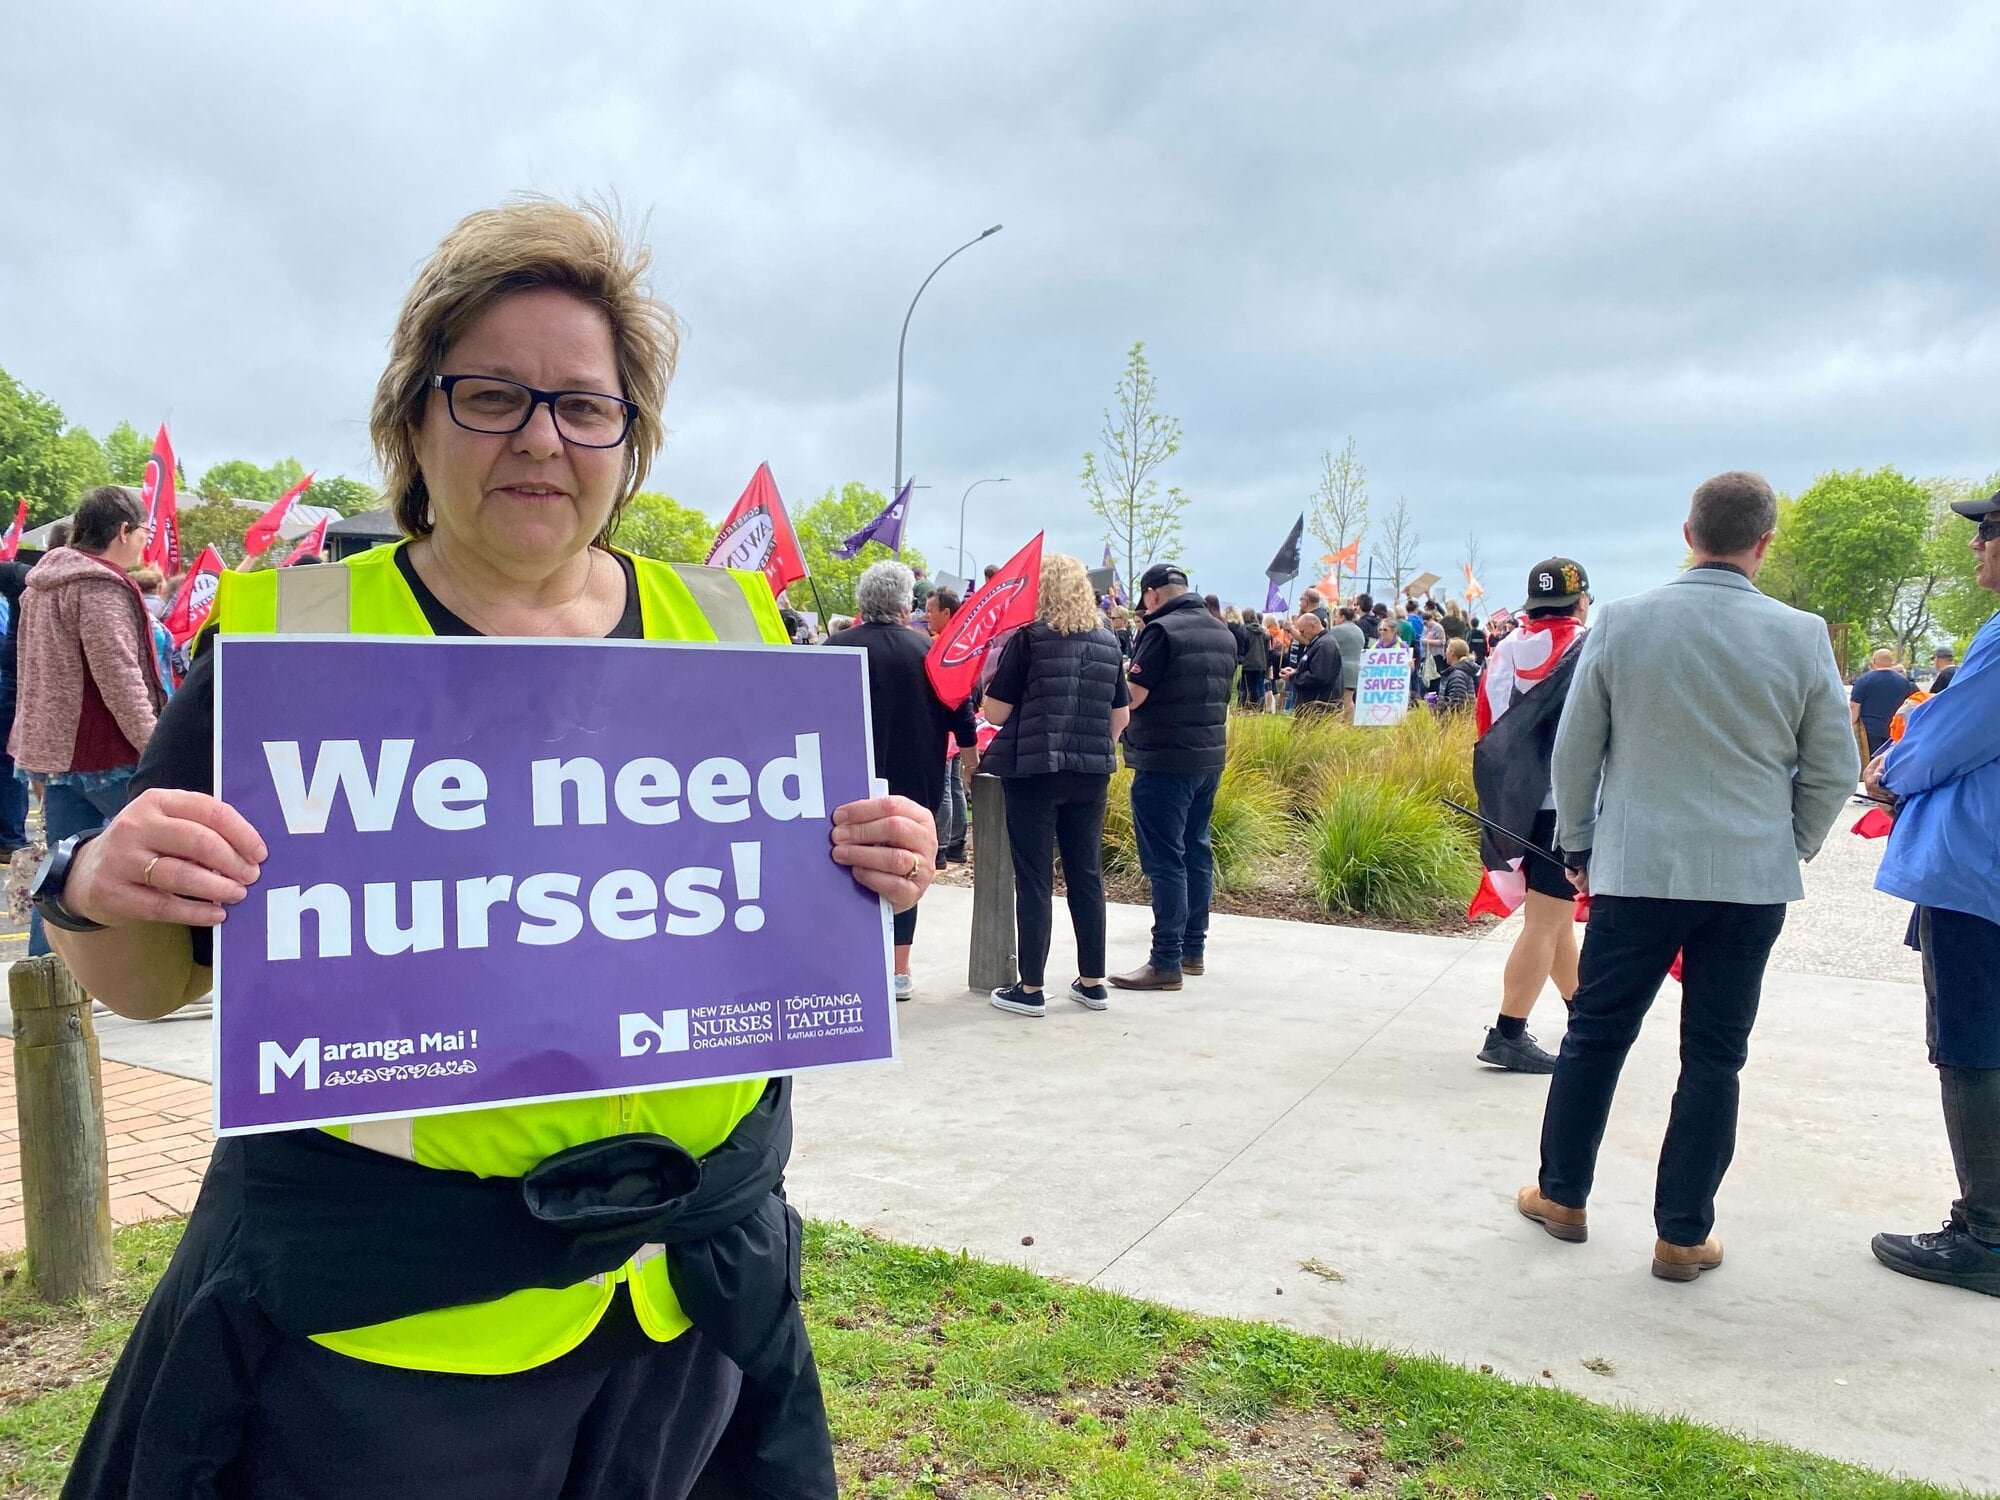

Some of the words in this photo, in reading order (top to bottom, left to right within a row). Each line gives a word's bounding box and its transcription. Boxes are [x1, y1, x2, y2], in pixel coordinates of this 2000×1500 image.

[1539, 572, 1554, 591] SD
[1367, 652, 1405, 665] SAFE
[1361, 665, 1409, 678] STAFFING
[1364, 678, 1405, 690] SAVES
[1363, 691, 1404, 704] LIVES
[262, 739, 488, 834] We
[531, 732, 826, 826] need
[266, 841, 765, 961] nurses!
[691, 1006, 718, 1018] NEW
[719, 1001, 772, 1016] ZEALAND
[784, 993, 862, 1011] TŌPŪTANGA
[692, 1014, 772, 1036] NURSES
[785, 1007, 863, 1029] TAPUHI
[692, 1032, 774, 1050] ORGANISATION
[787, 1030, 817, 1040] KAITIAKI
[817, 1029, 825, 1037] O
[825, 1026, 864, 1036] AOTEAROA
[259, 1038, 416, 1094] Maranga
